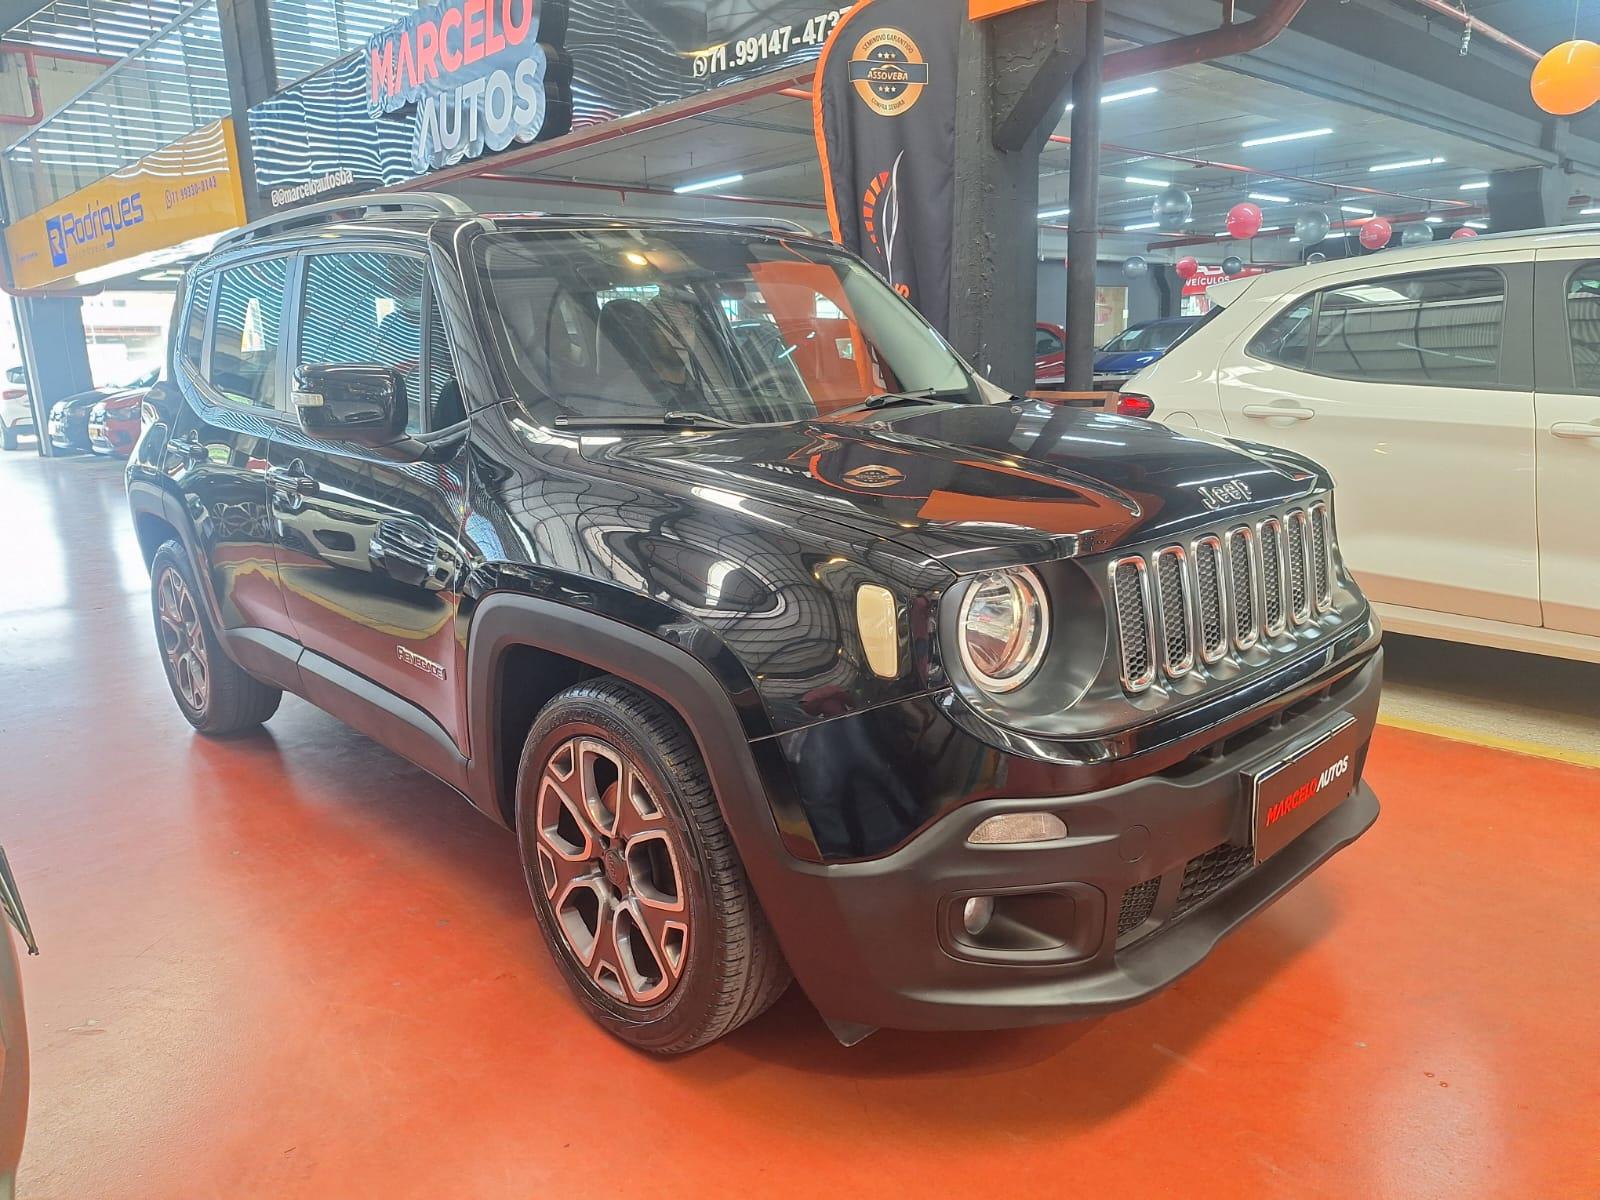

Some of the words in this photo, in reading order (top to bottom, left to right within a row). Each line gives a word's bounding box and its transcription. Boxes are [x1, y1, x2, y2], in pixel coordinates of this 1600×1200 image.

[371, 0, 533, 103] MARCELO
[710, 6, 853, 74] 71.99147-473
[867, 71, 908, 81] ASSOVEBA
[418, 58, 538, 159] AUTOS
[278, 169, 354, 206] @marceloautosba
[62, 192, 144, 248] Rodrigues
[1185, 276, 1230, 287] VEÍCULOS
[1198, 479, 1252, 510] Jeep
[397, 645, 444, 680] RENEGADE
